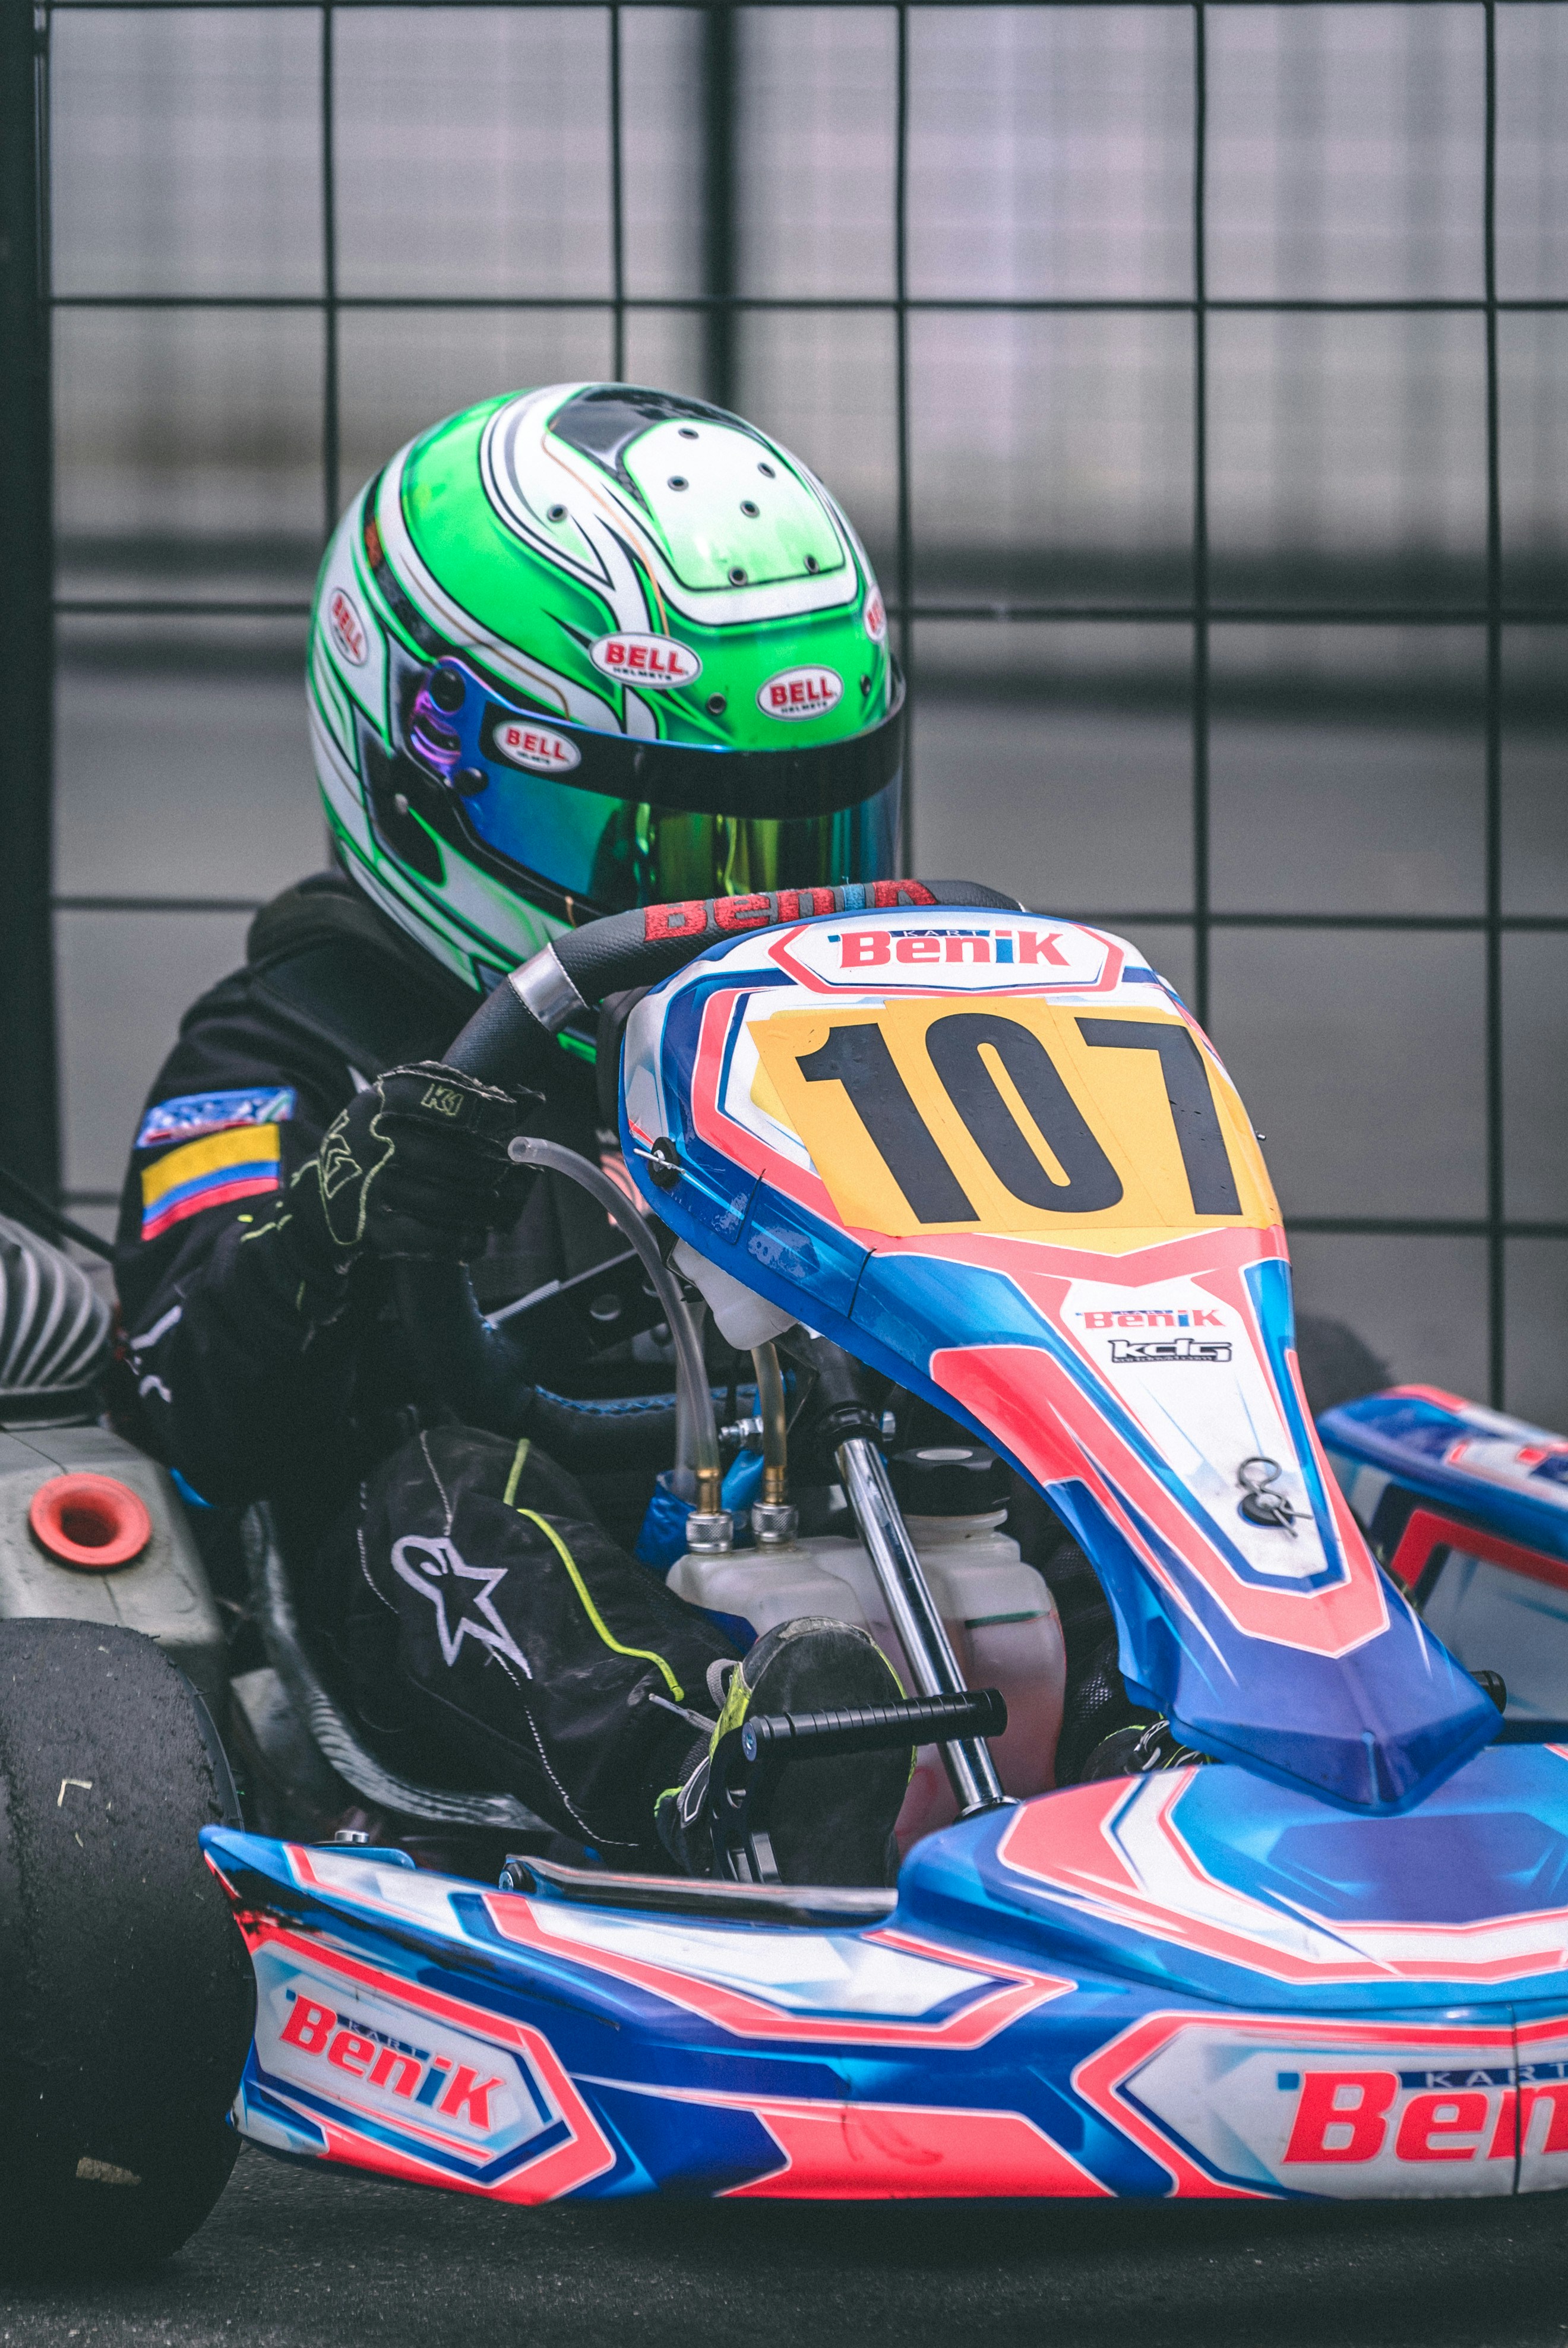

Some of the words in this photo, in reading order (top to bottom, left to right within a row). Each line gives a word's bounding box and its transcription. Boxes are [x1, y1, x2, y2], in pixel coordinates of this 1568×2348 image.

[333, 594, 361, 656] BELL
[605, 641, 685, 675] BELL
[613, 666, 672, 681] HELMETS
[770, 677, 833, 707] BELL
[507, 727, 567, 761] BELL
[795, 1012, 1244, 1224] 107
[348, 2020, 419, 2057] KART
[1425, 2062, 1568, 2089] KART
